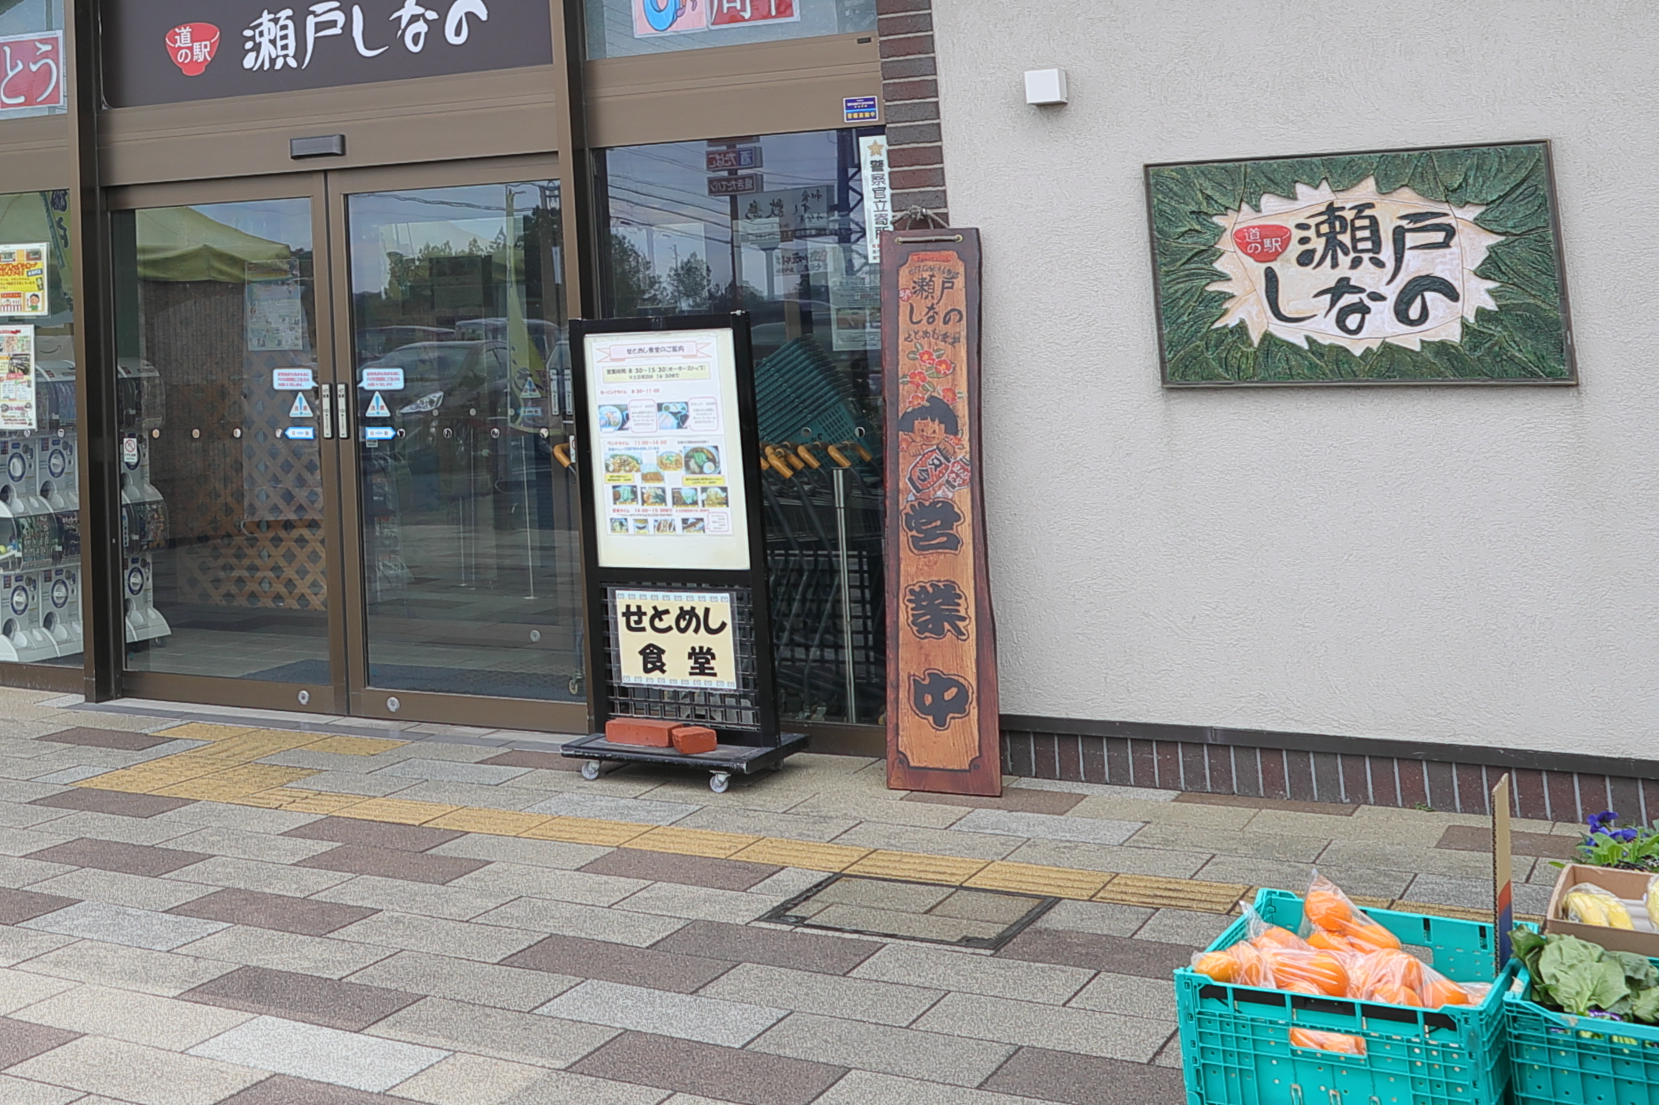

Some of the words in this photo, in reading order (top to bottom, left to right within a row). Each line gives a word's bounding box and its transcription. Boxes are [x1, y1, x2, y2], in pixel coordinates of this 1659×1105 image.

[174, 26, 212, 64] 道の駅
[1244, 227, 1282, 254] 道の駅
[1294, 202, 1457, 286] 瀬戸
[911, 273, 955, 306] 瀬戸
[1263, 265, 1461, 336] しなの
[908, 302, 964, 326] しなの
[621, 603, 728, 635] せとめし
[903, 500, 971, 728] 営業中
[638, 643, 718, 678] 食堂
